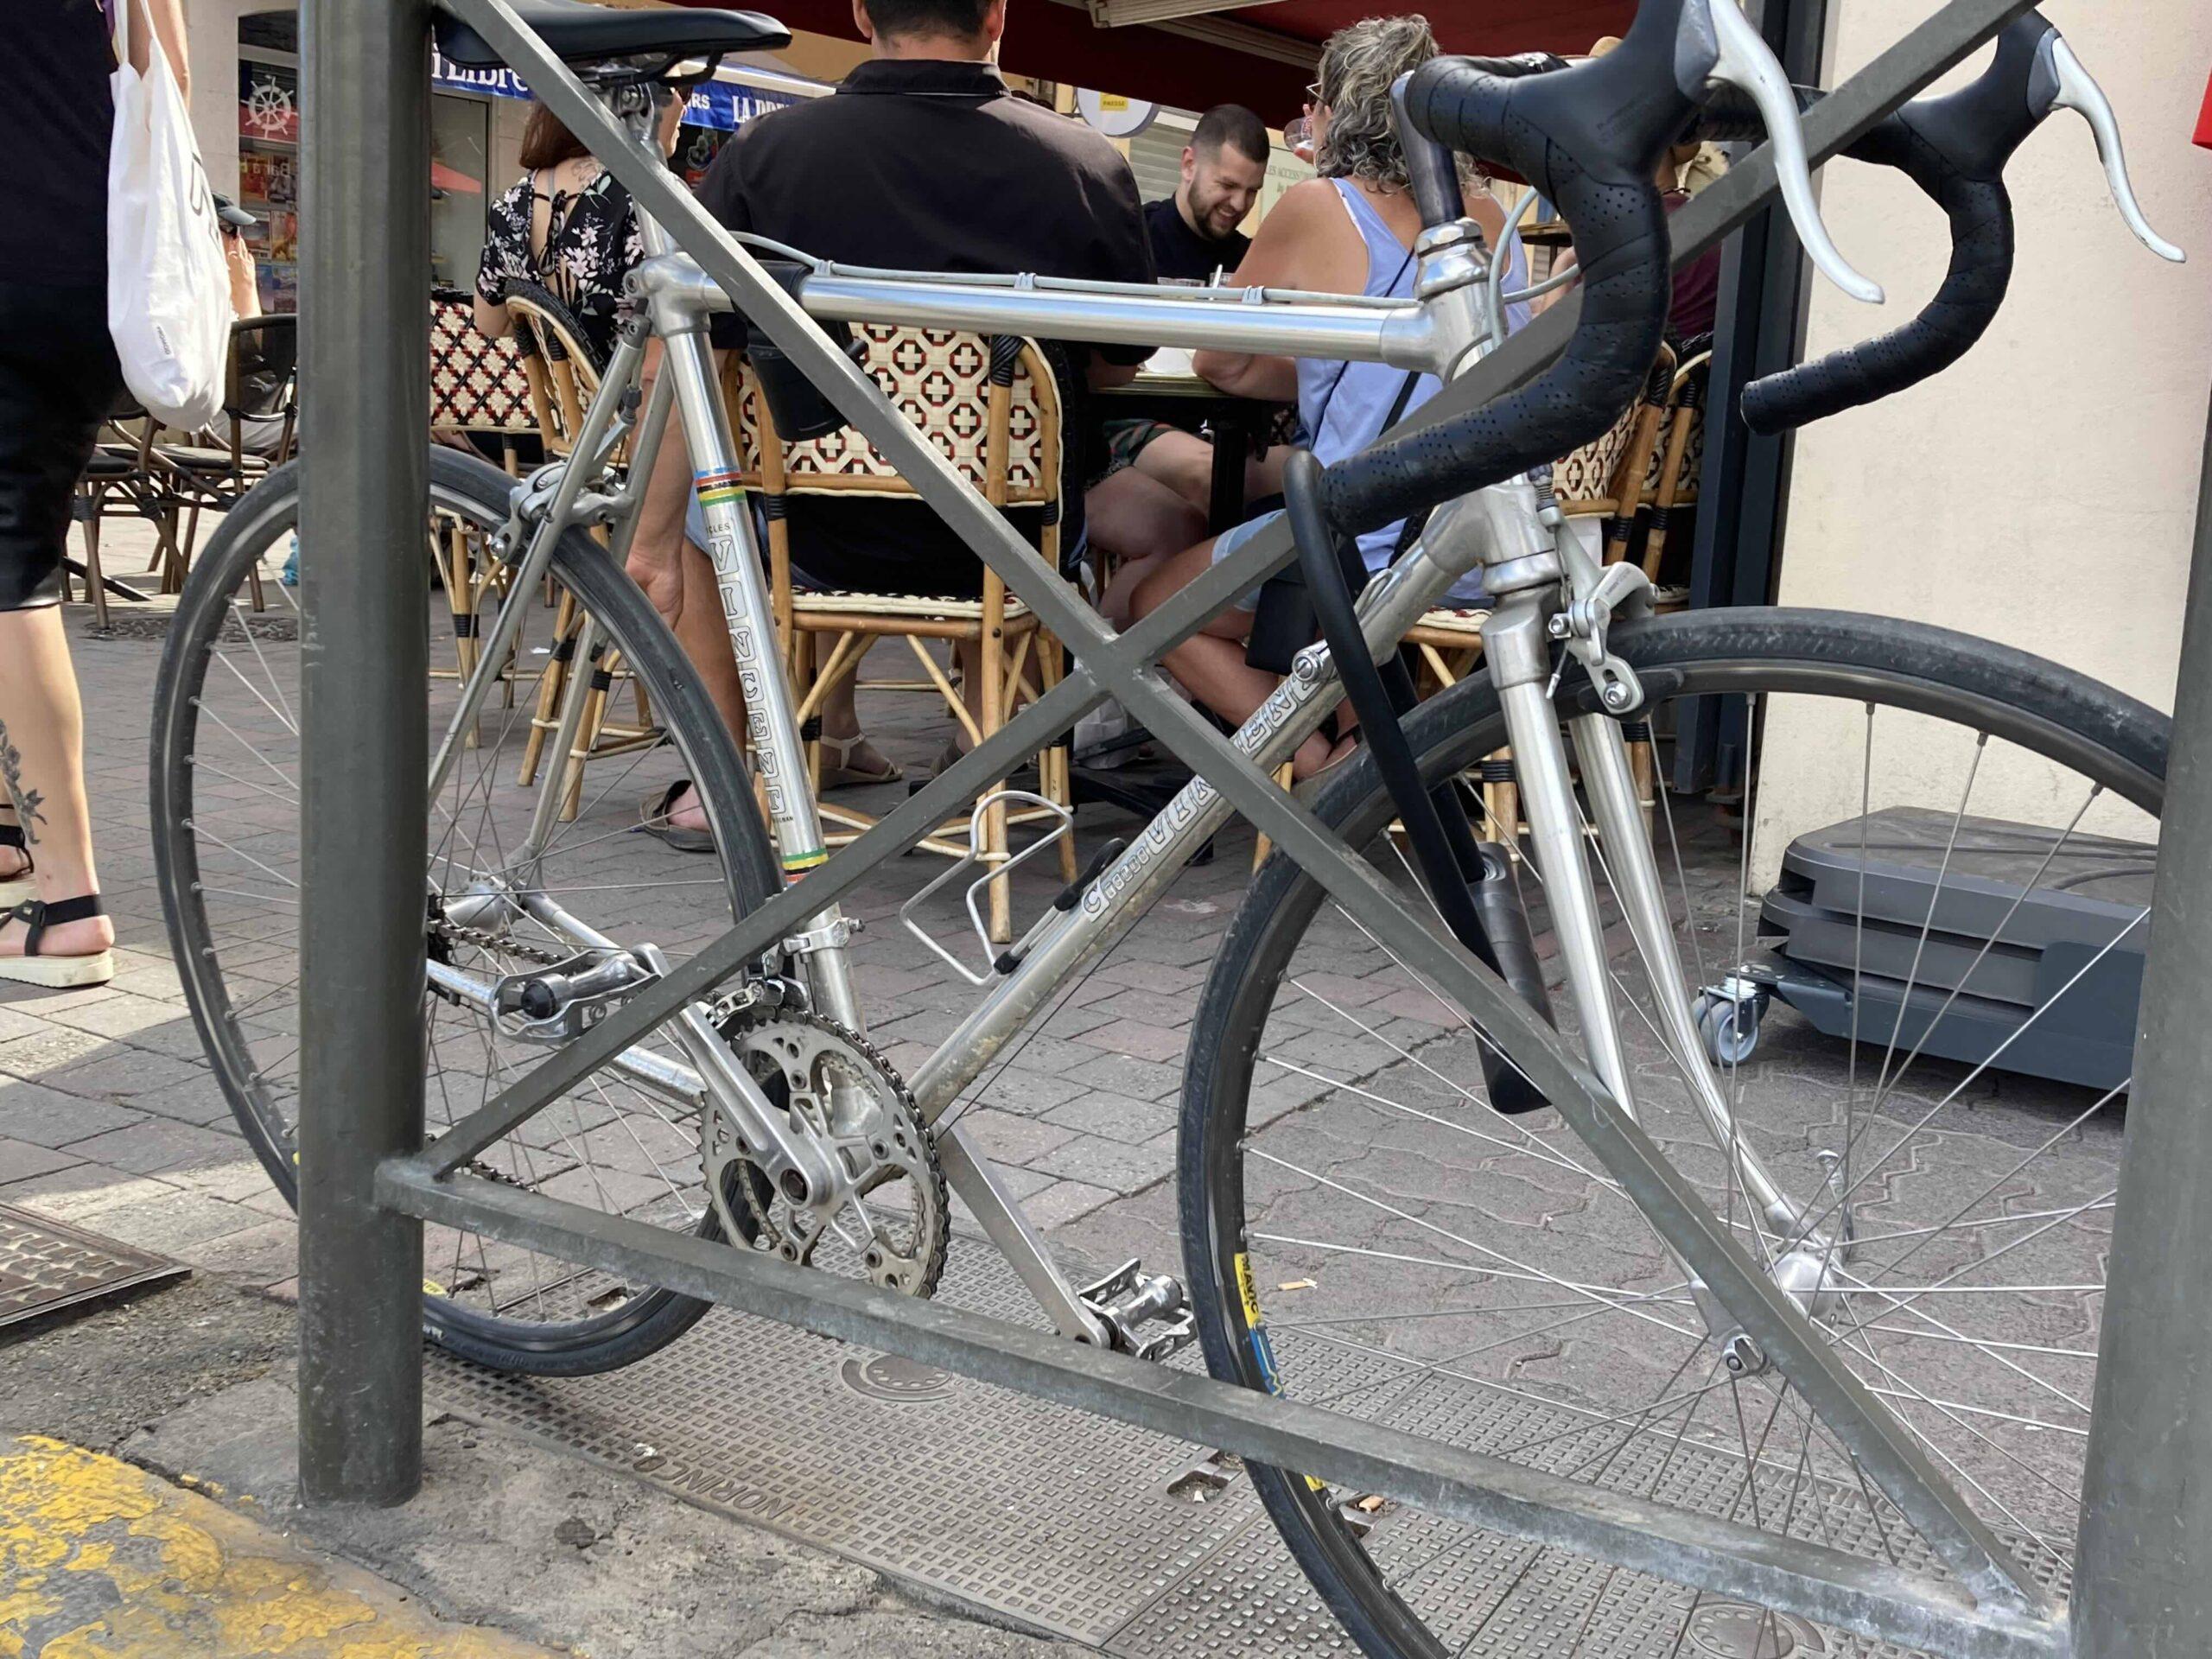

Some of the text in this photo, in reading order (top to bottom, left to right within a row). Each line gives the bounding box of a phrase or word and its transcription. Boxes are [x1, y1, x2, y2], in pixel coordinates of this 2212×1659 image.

[1242, 1255, 1259, 1314] MAVIC
[632, 1455, 796, 1521] NORINCO
[1752, 1465, 1902, 1522] NORINC
